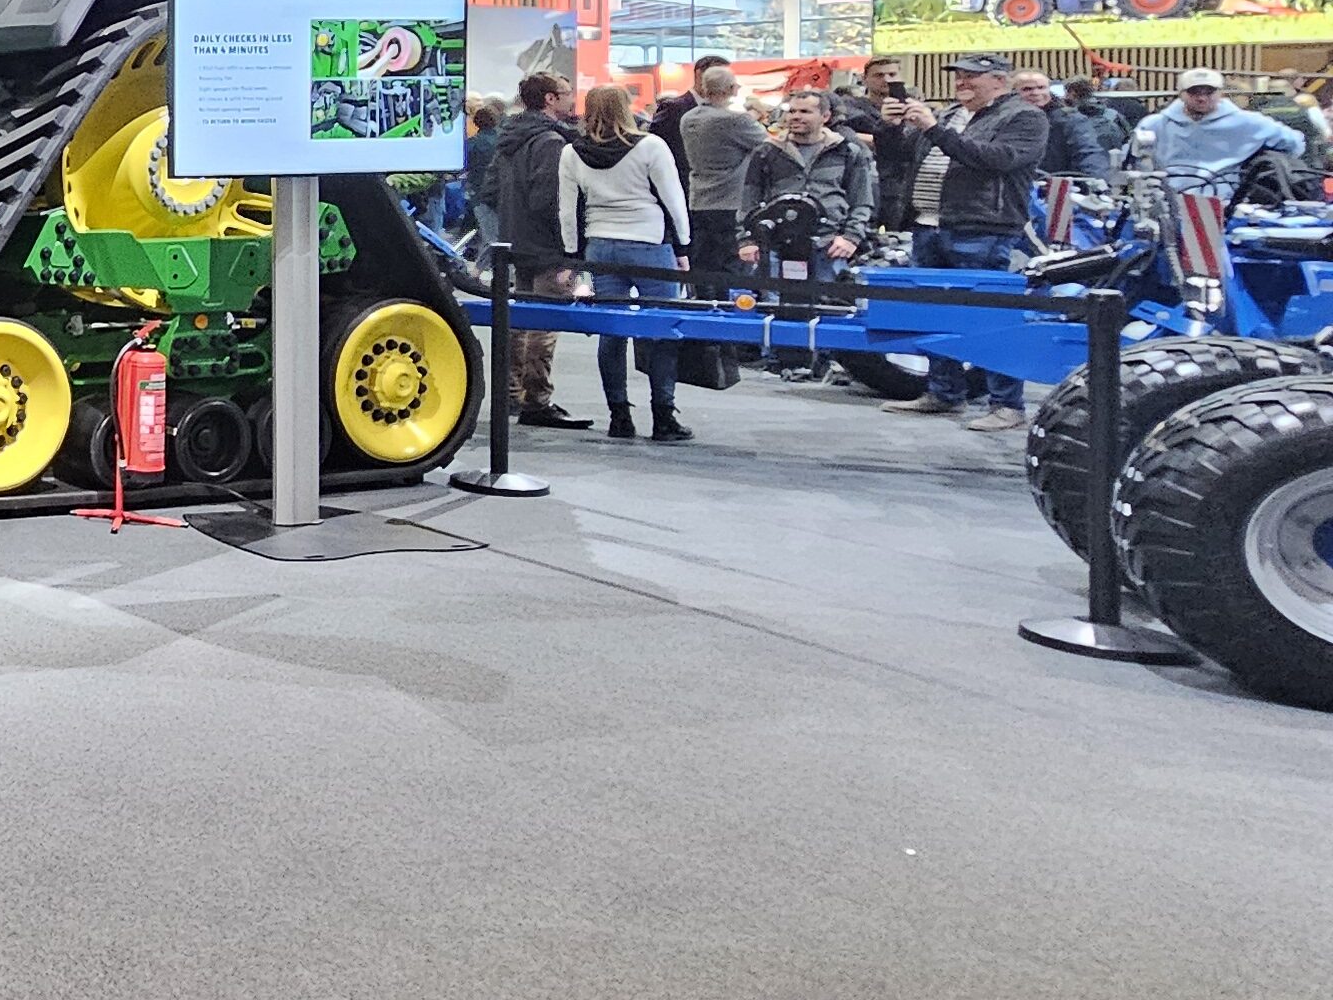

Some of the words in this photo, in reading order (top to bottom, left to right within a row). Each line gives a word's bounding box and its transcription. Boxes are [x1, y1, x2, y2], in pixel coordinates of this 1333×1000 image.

[193, 34, 221, 43] DAILY
[223, 34, 257, 43] CHECKS
[259, 34, 269, 43] IN
[272, 34, 292, 43] LESS
[193, 46, 218, 54] THAN
[228, 45, 269, 54] MINUTES
